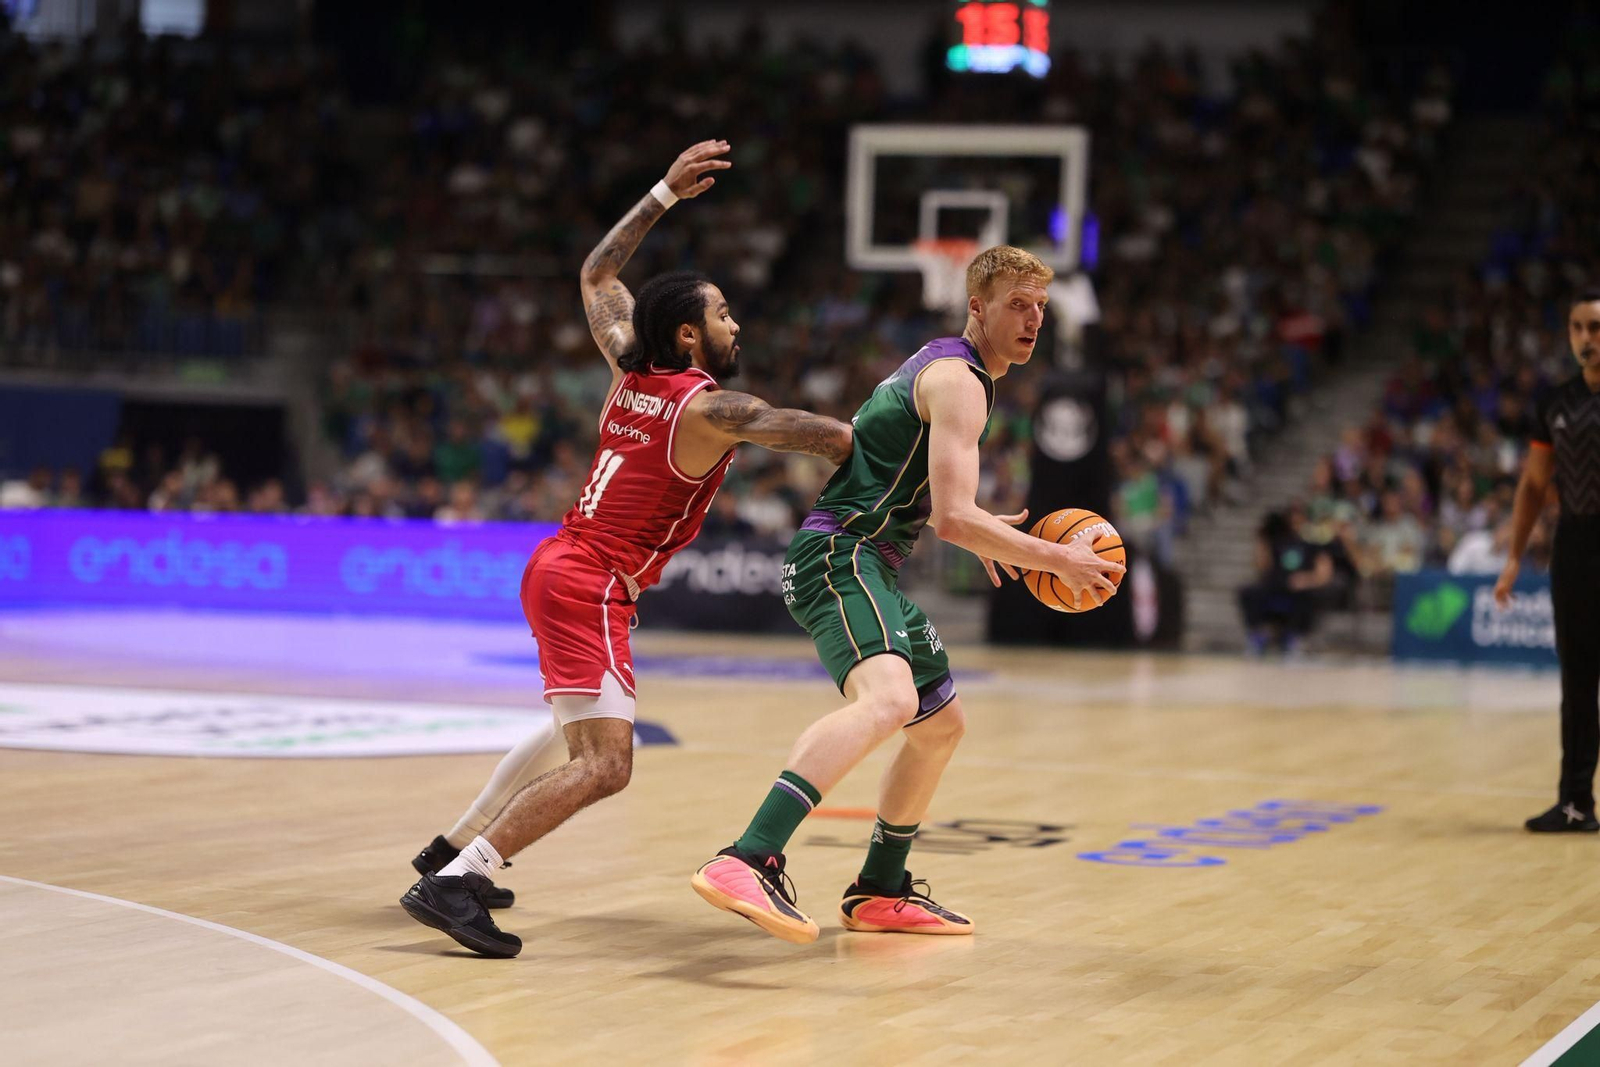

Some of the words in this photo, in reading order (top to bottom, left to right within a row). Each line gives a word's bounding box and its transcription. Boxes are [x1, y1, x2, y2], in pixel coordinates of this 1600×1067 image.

[579, 449, 625, 519] 11
[69, 530, 289, 590] endesa
[340, 540, 523, 600] endes
